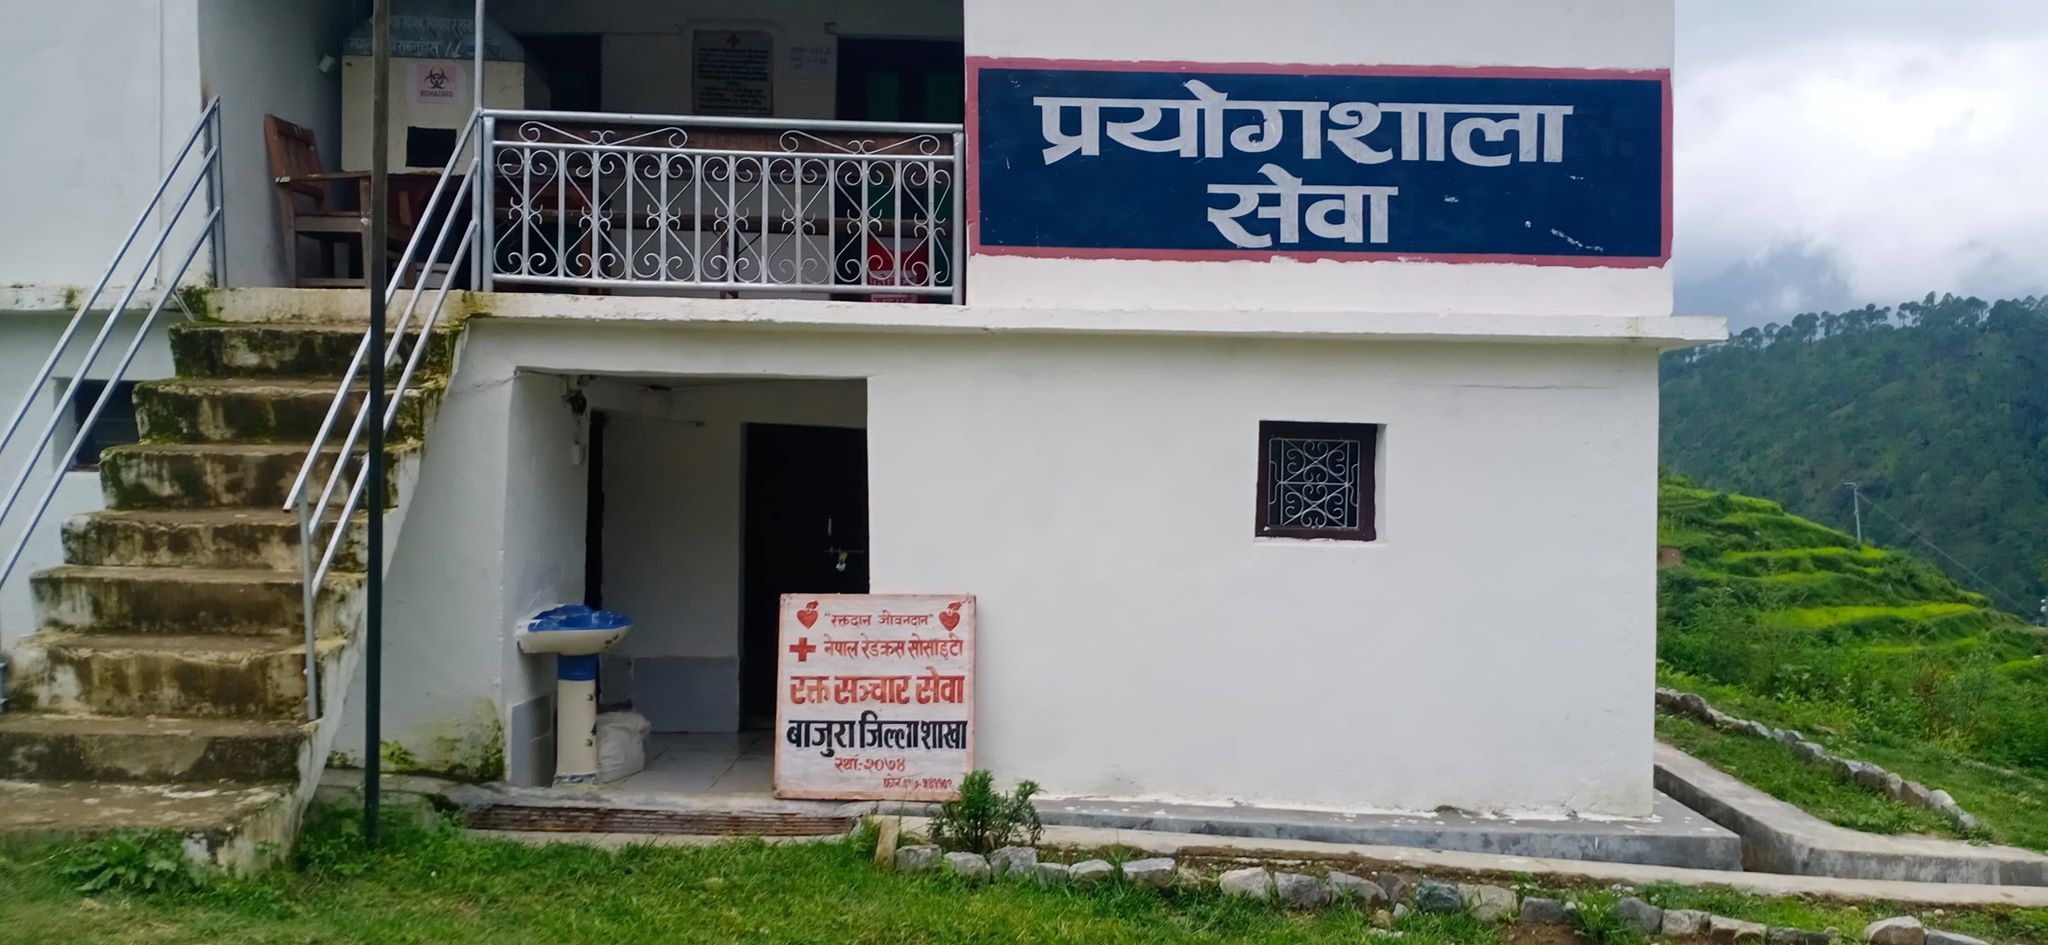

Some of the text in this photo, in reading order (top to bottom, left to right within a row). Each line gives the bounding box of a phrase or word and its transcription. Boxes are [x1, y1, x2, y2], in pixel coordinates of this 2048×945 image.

[420, 90, 454, 98] BIOHAZARD
[1034, 79, 1574, 167] प्रयोगशाला
[1207, 163, 1399, 249] सेवा
[824, 633, 859, 659] नेपाल
[790, 675, 829, 704] रक्त
[915, 666, 965, 704] सेवा
[786, 710, 968, 757] बाजुरा जिल्ला शाखा
